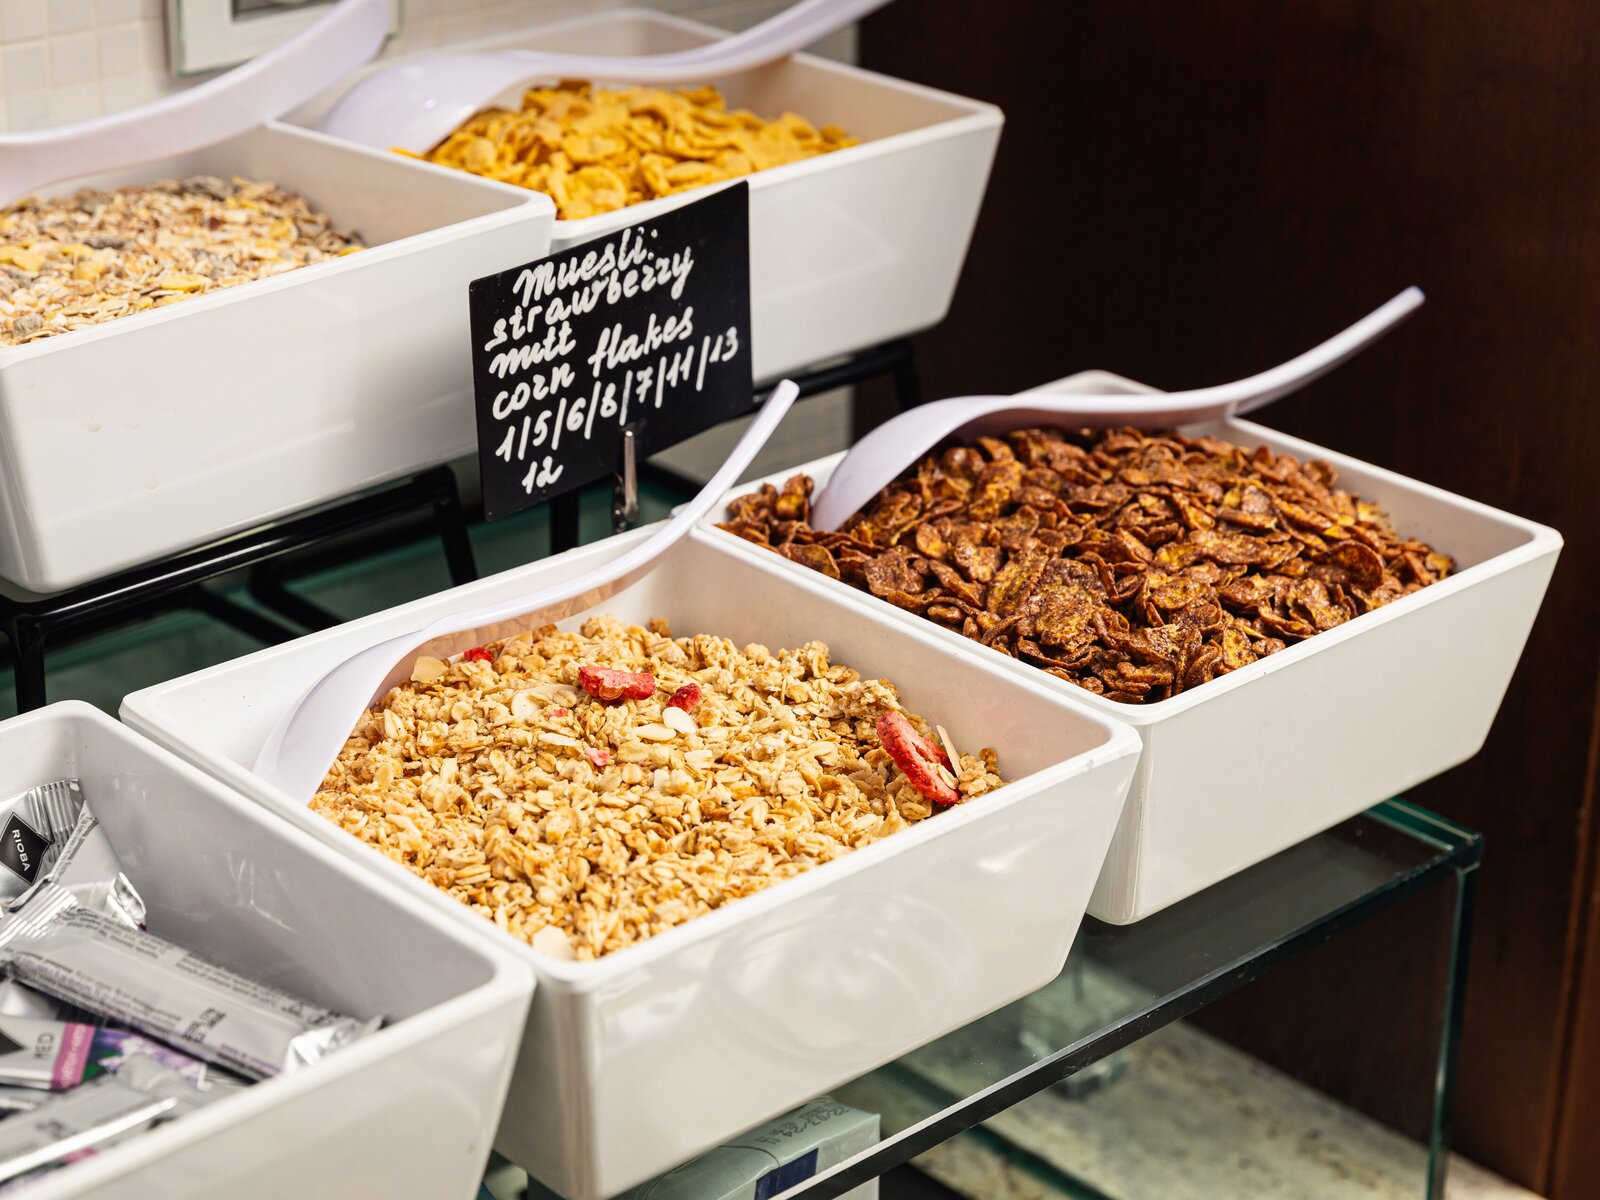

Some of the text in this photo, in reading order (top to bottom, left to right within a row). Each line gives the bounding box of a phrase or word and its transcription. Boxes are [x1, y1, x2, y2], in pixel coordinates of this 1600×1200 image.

[492, 306, 694, 421] corn flakes
[521, 455, 564, 495] 12
[11, 829, 31, 872] RIOBA
